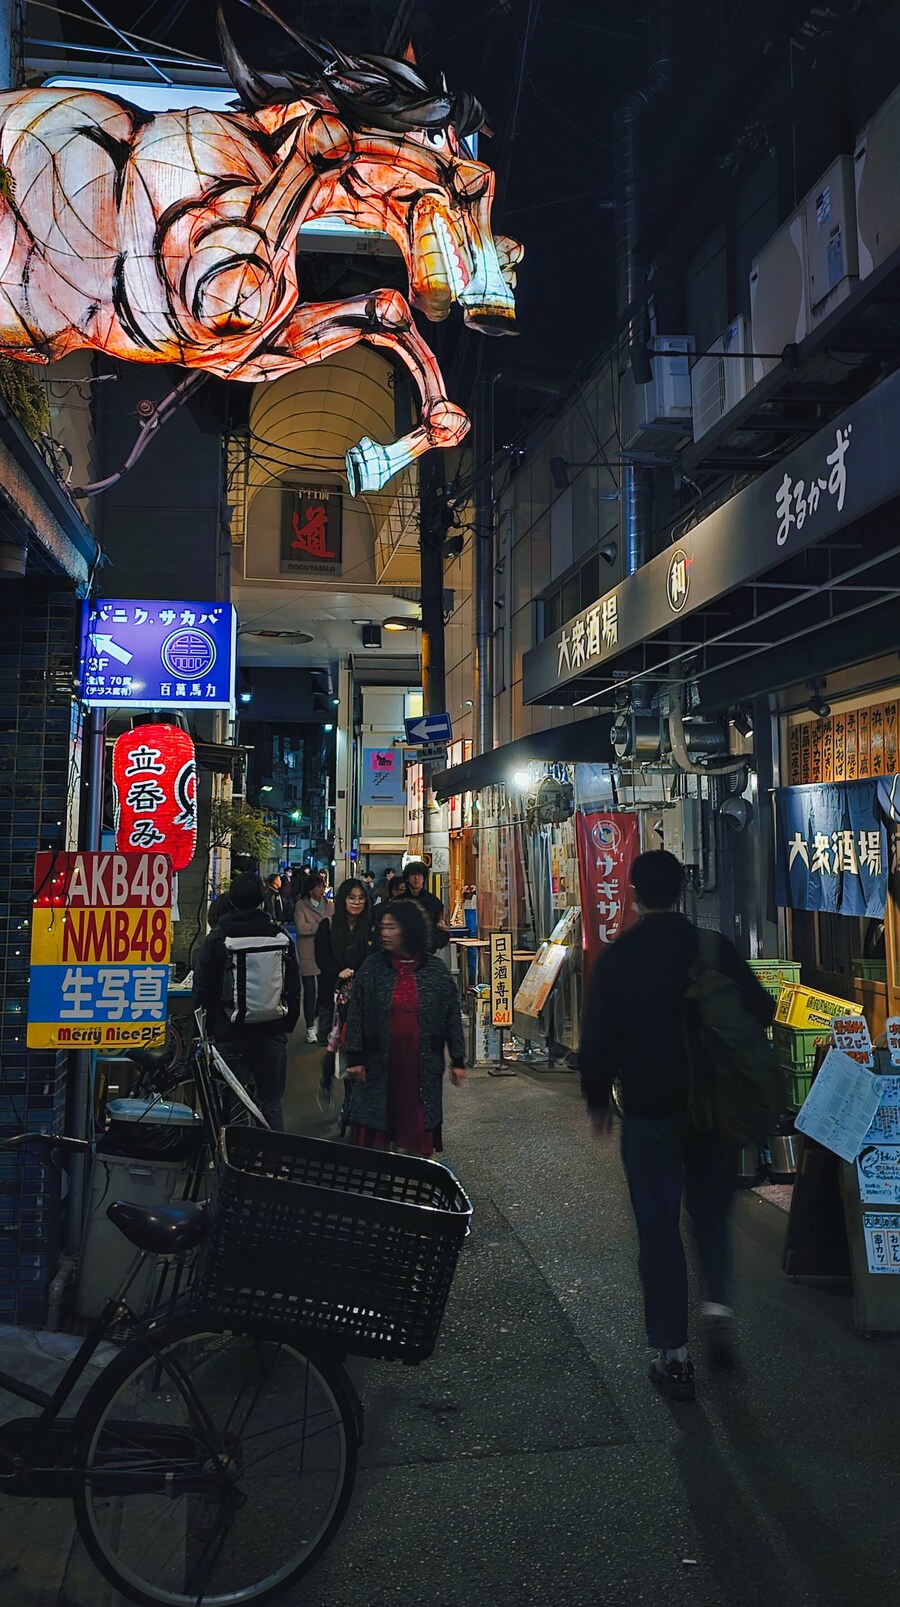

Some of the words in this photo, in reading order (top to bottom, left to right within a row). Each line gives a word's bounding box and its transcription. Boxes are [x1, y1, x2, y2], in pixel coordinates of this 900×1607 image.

[775, 423, 852, 546] まるかず
[291, 506, 336, 558] 道
[288, 563, 336, 573] DOGUYASUJI
[671, 558, 686, 603] 和
[557, 594, 618, 677] 大衆酒場
[88, 657, 109, 671] 3F
[160, 682, 217, 698] 百萬馬力
[835, 721, 845, 776] ねばねば
[124, 744, 166, 848] 立呑み
[65, 853, 169, 907] AKB48
[788, 830, 882, 877] 大衆酒場
[62, 909, 167, 963] NMB48
[60, 966, 166, 1020] 生写真
[493, 937, 511, 1011] 日本酒専門
[58, 1027, 102, 1045] Merry
[874, 1234, 884, 1263] 串カツ
